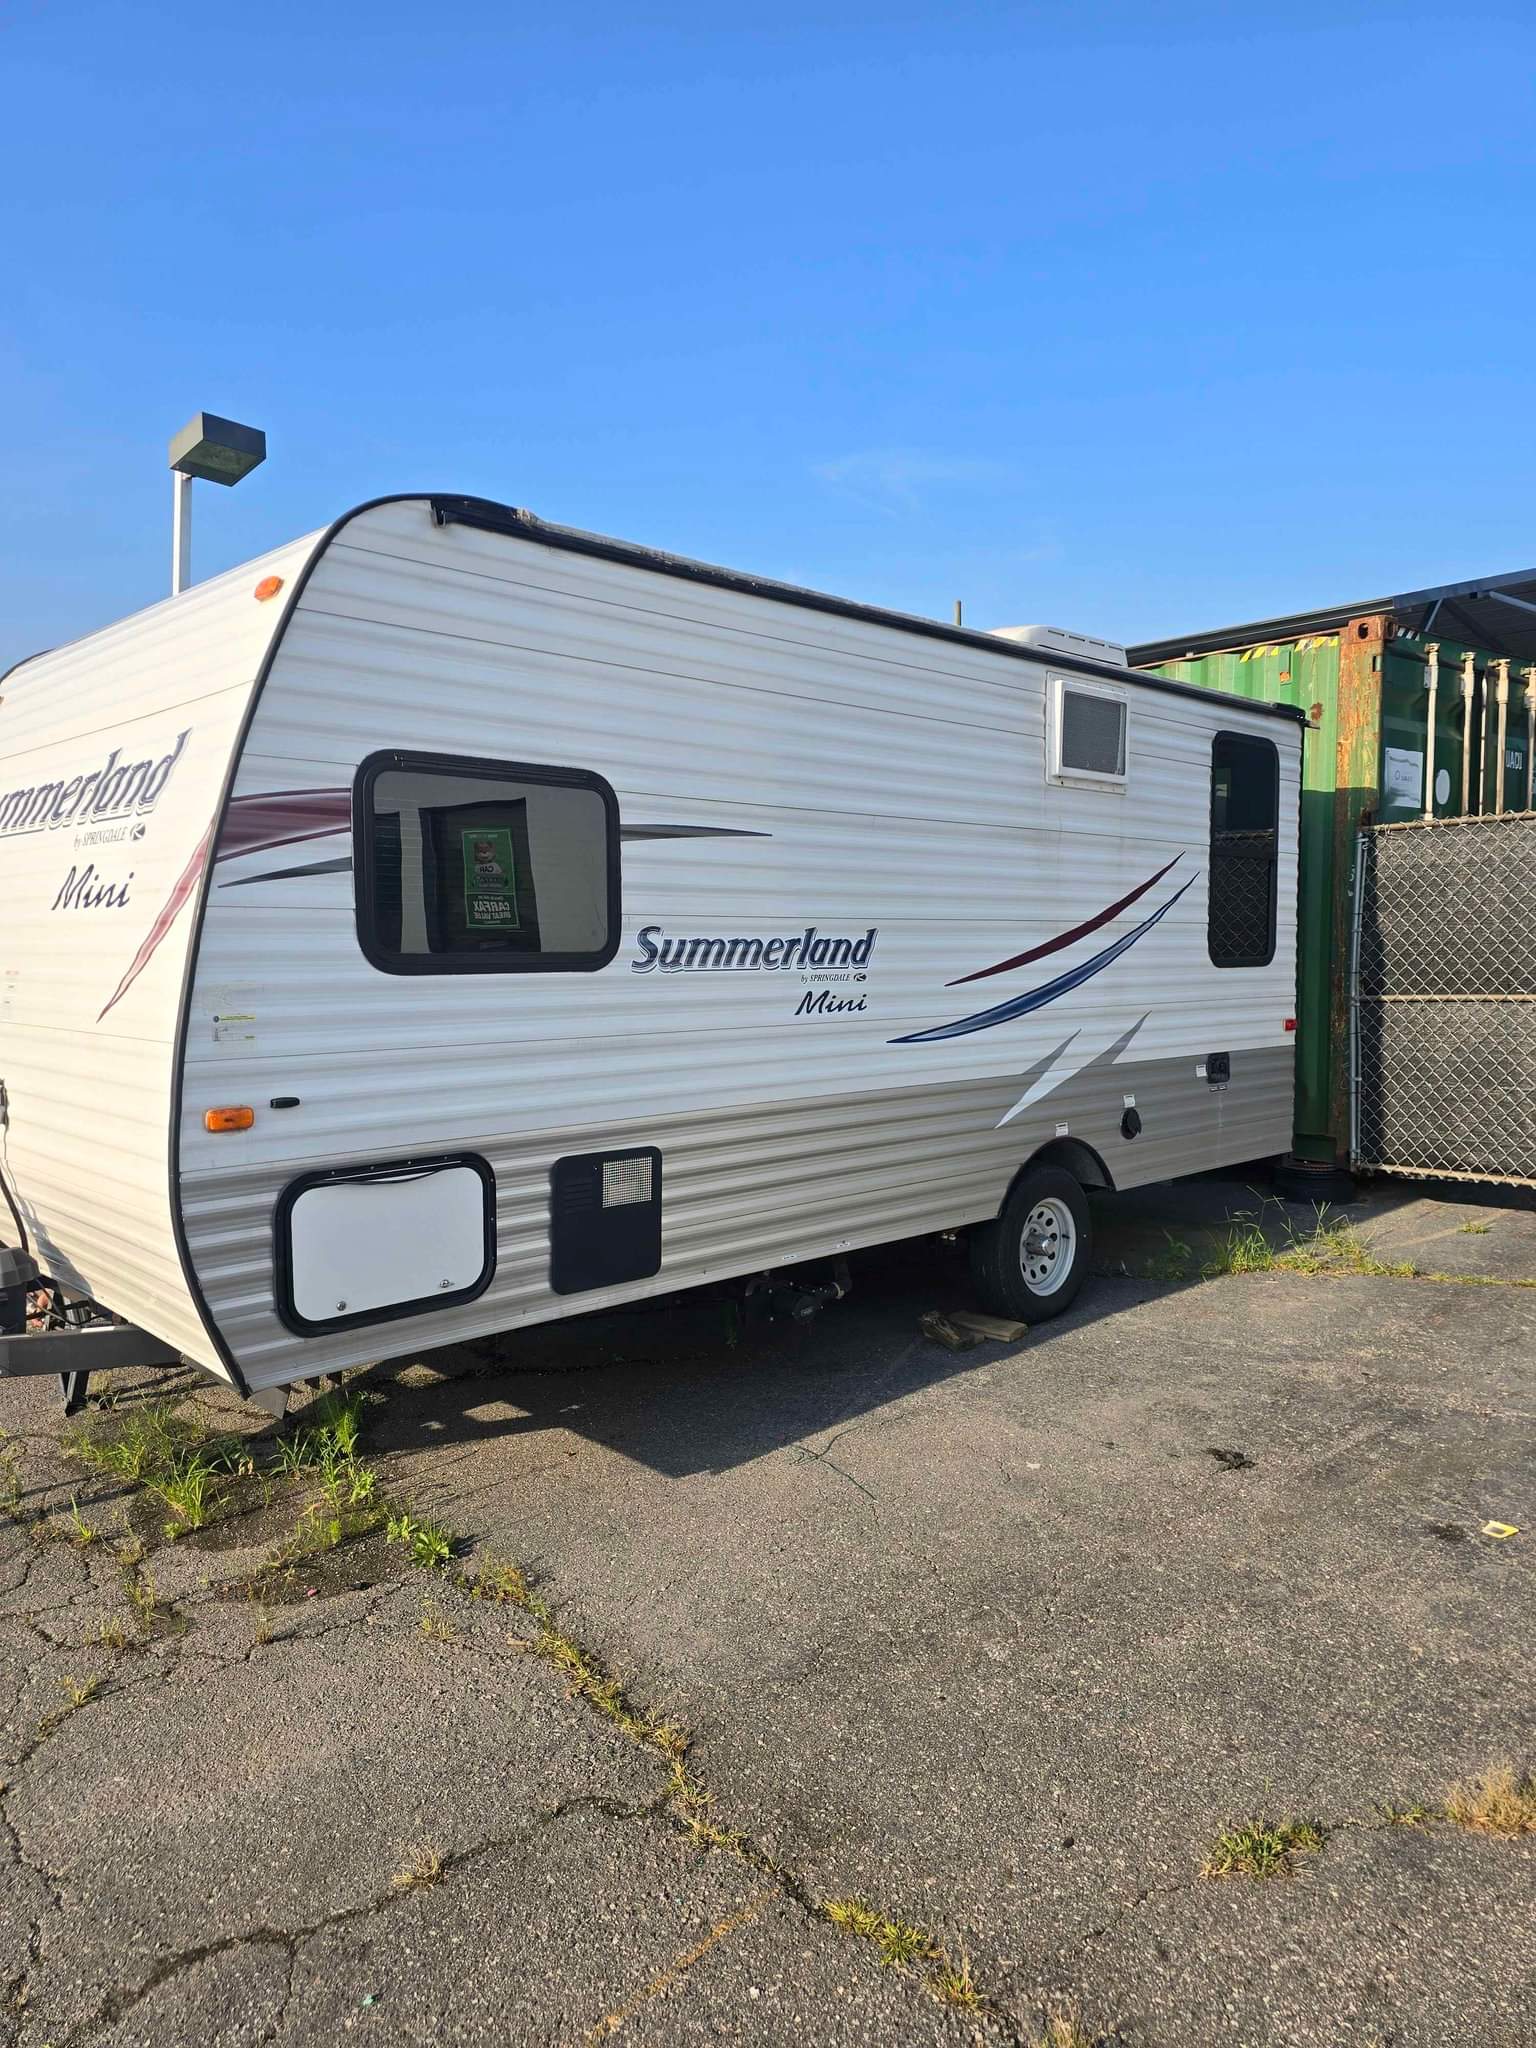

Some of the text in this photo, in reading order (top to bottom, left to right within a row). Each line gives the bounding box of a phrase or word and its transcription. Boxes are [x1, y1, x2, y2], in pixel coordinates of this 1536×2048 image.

[0, 727, 192, 836] mmerland
[82, 827, 127, 846] SPRINGDALE
[52, 864, 134, 911] Mini
[631, 925, 878, 973] Summerland
[801, 974, 850, 984] by SPRINGDALE
[794, 990, 867, 1015] Mini
